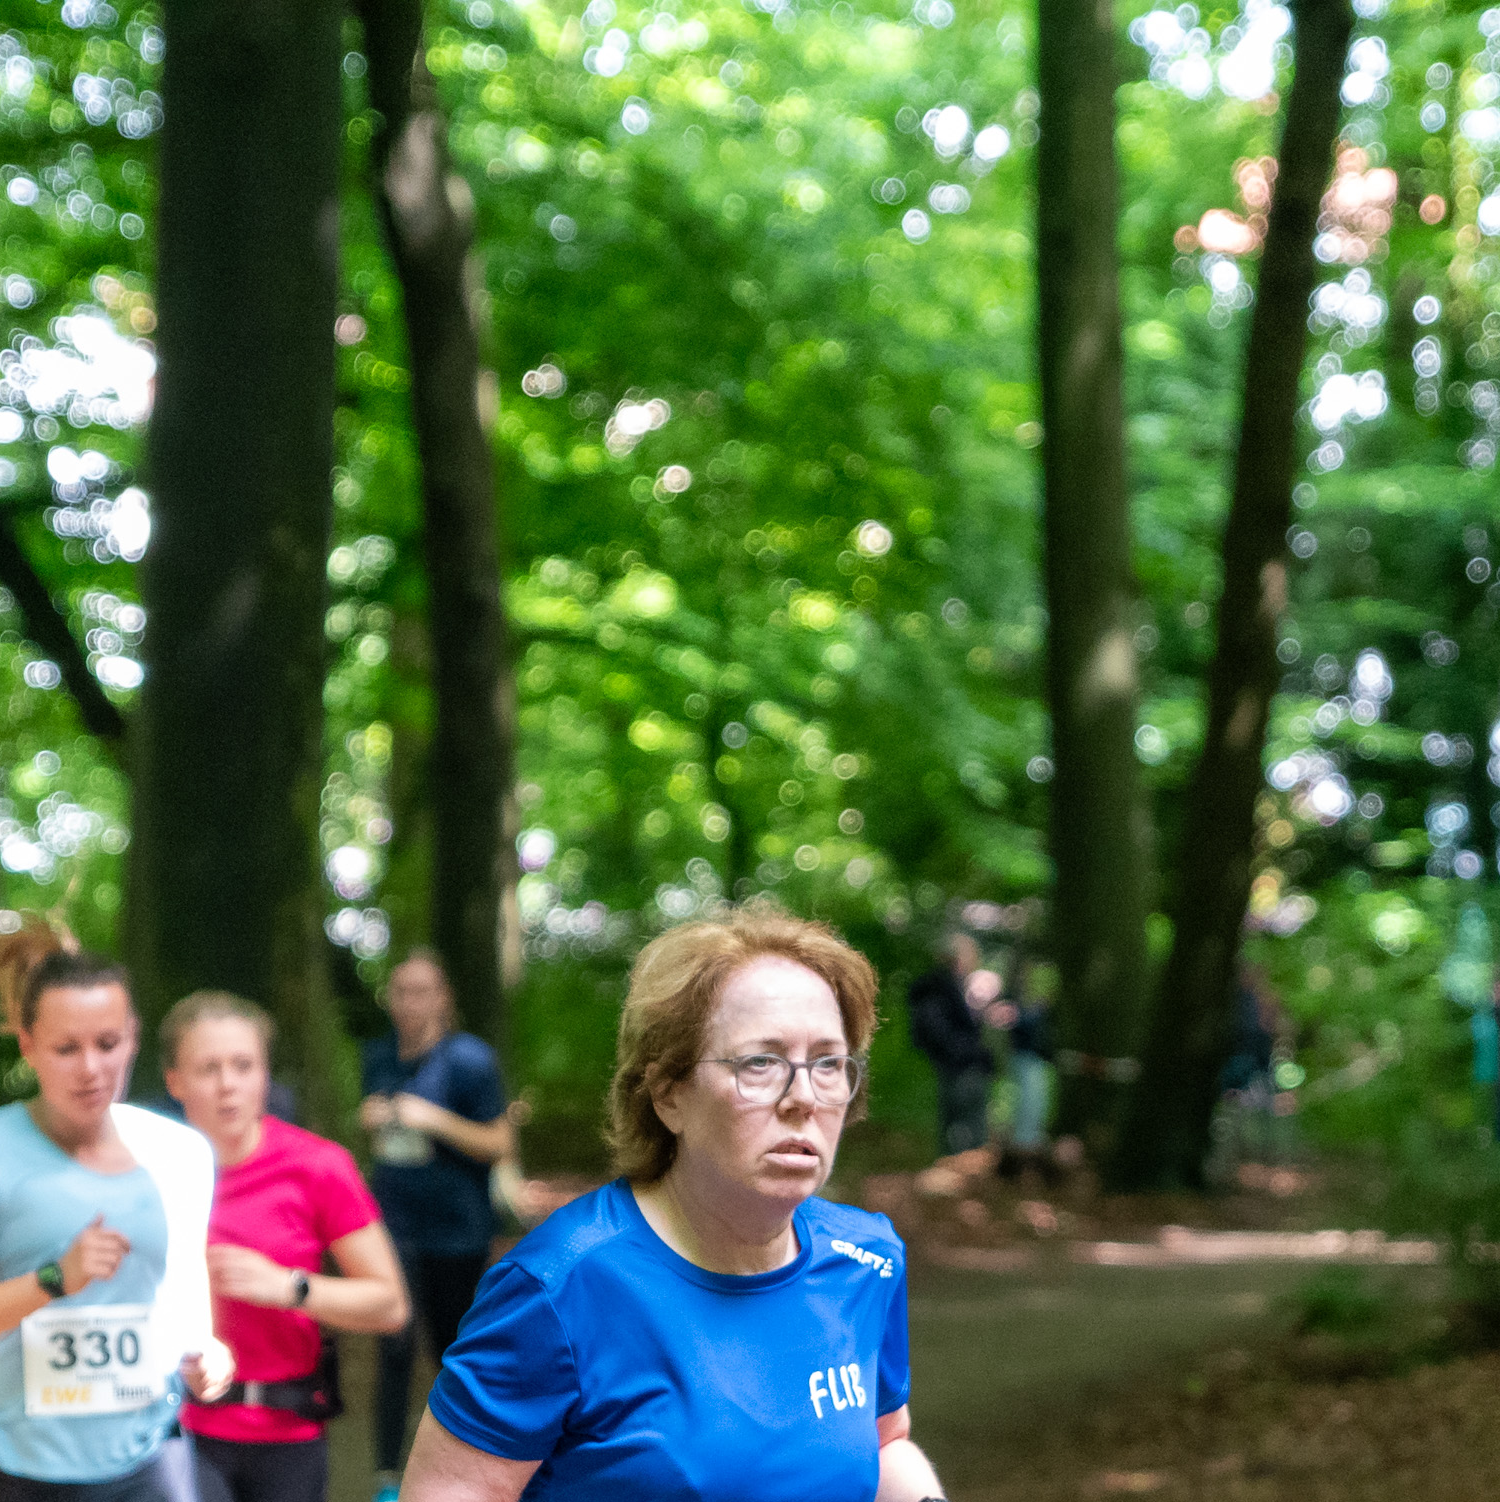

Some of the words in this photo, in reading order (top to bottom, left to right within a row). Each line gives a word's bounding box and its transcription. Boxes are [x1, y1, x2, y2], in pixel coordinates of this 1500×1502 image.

[831, 1240, 885, 1270] CRAFT
[49, 1329, 140, 1370] 330
[809, 1363, 866, 1418] FLIB
